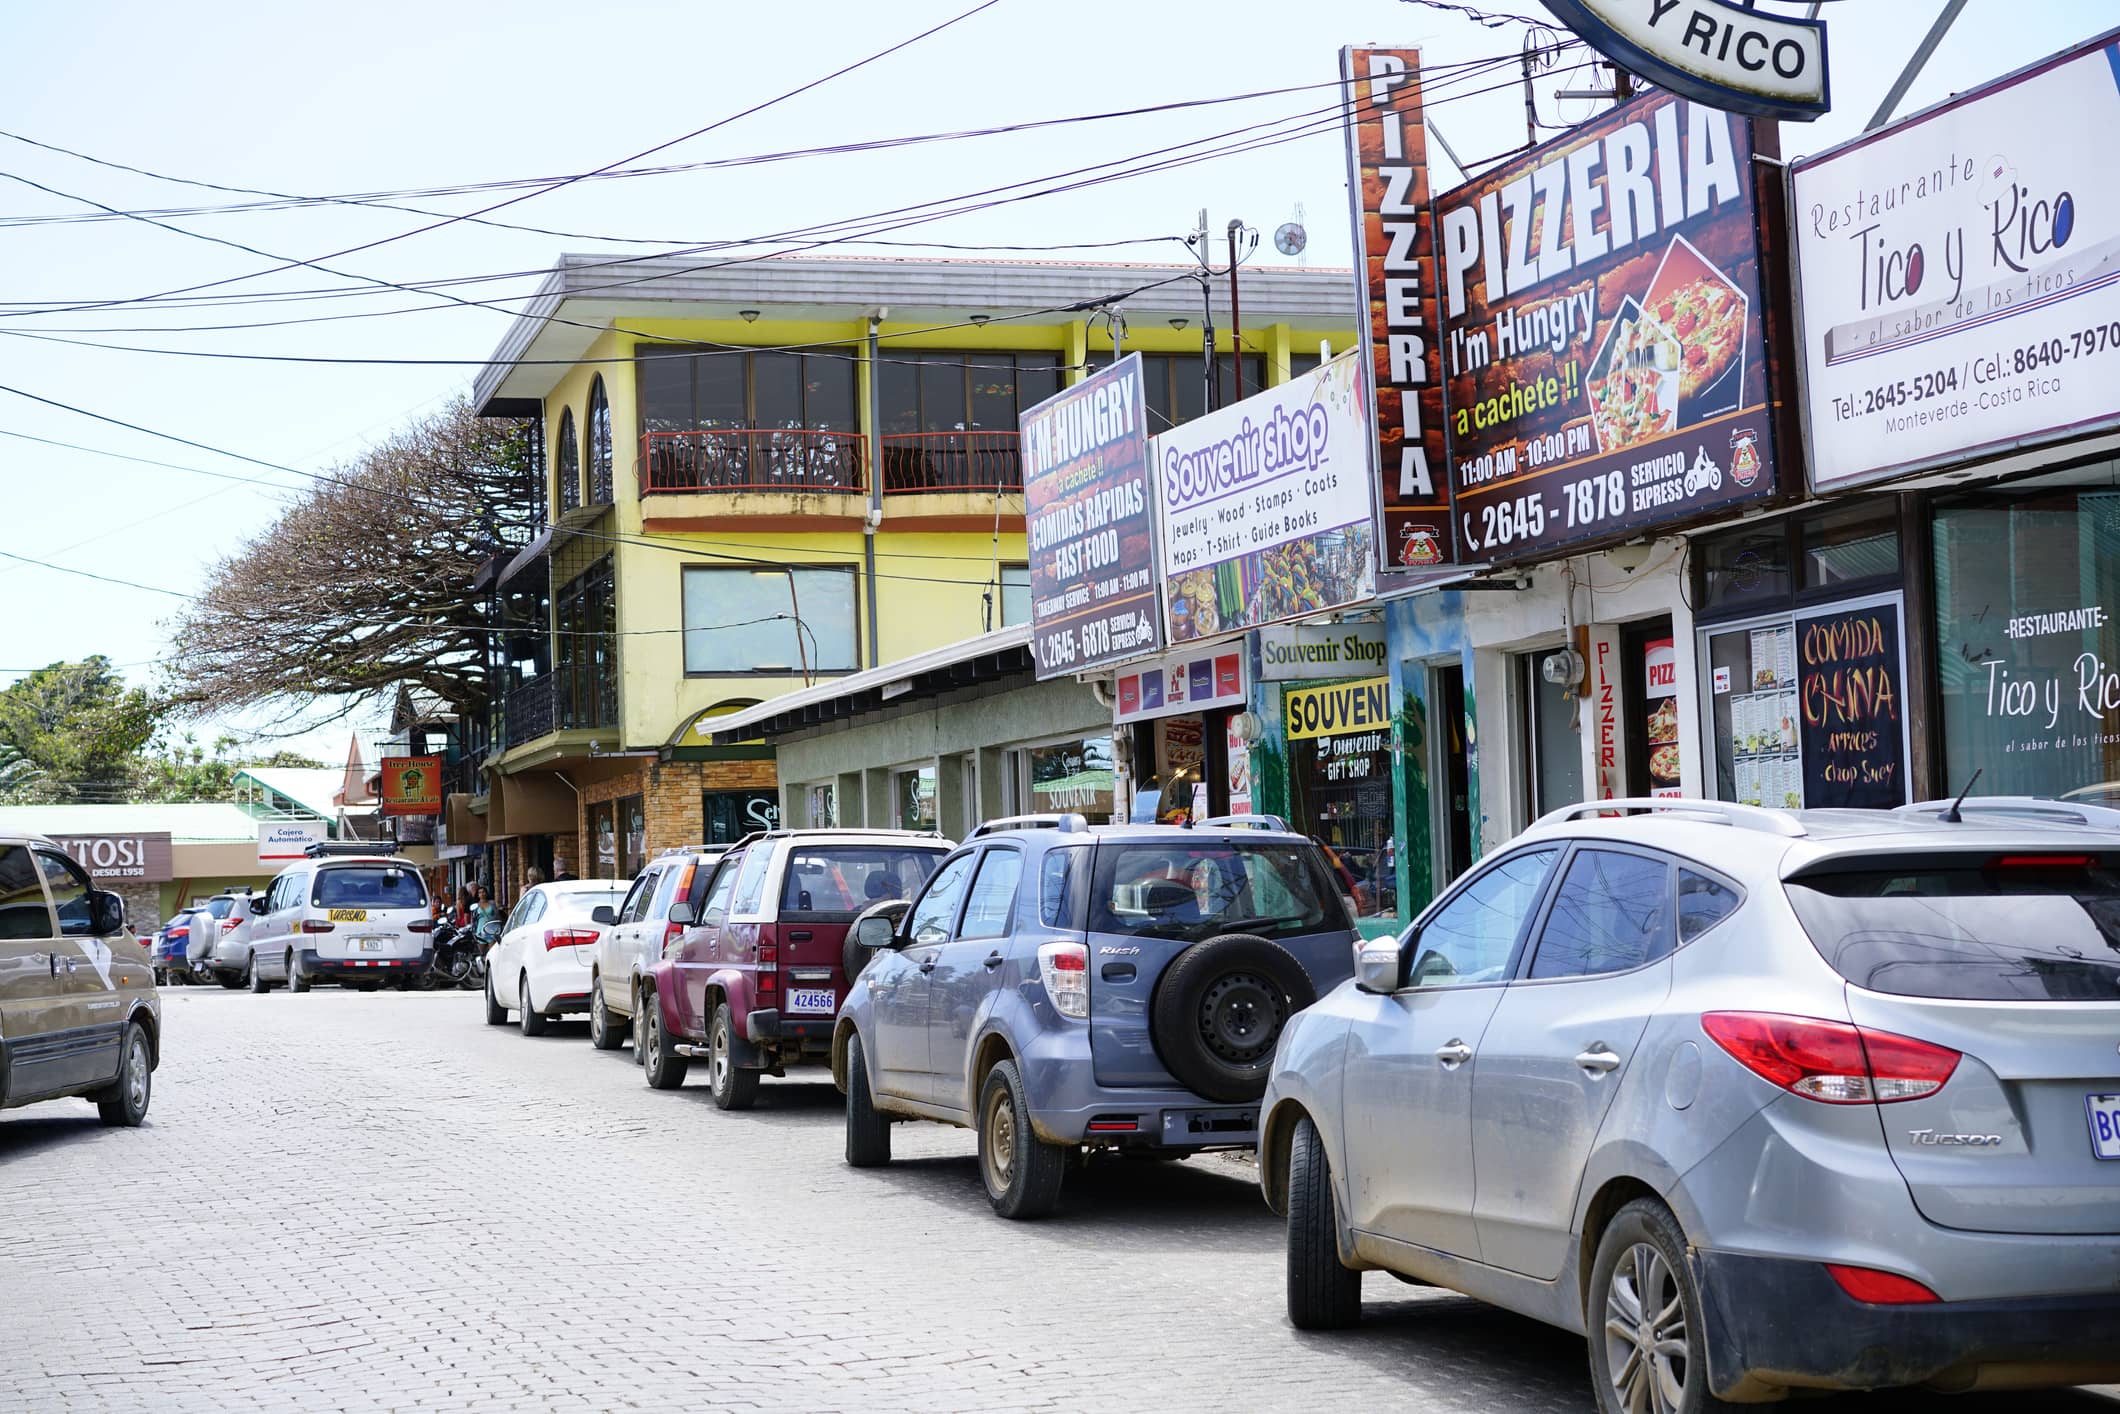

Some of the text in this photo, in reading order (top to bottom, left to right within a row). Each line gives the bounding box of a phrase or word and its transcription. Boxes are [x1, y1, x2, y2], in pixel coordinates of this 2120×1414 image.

[1648, 0, 1805, 79] Y RICO
[1443, 101, 1740, 318] PIZZERIA
[1811, 153, 1974, 239] Restaurante
[1849, 182, 2075, 311] Tico y Rico
[1367, 55, 1432, 496] PIZZERIA
[1451, 287, 1595, 377] I'm Hungry
[1869, 268, 2074, 345] el sabor de los ticos
[1026, 372, 1135, 478] I'M HUNGRY
[1457, 360, 1578, 436] a cachete !!
[1886, 398, 1968, 434] Monteverde
[2028, 376, 2061, 398] Rica
[1058, 479, 1064, 492] a
[1065, 466, 1097, 489] cachete
[1166, 402, 1328, 506] Souvenir shop
[1460, 455, 1493, 486] 11:00
[1496, 447, 1517, 477] AM
[1526, 431, 1565, 467] 10:00
[1567, 424, 1590, 455] PM
[1631, 451, 1685, 487] SERVICIO
[1032, 478, 1144, 552] COMIDAS RÁPIDAS
[1172, 472, 1337, 544] Jewelry Wood Stamps Coats
[1481, 492, 1544, 549] 2645
[1563, 470, 1625, 528] 7878
[1632, 477, 1683, 512] EXPRESS
[1055, 528, 1119, 581] FAST FOOD
[1173, 509, 1318, 566] Maps T-Shirt Guide Books
[1038, 595, 1065, 618] TAKEAWAY
[1065, 587, 1090, 608] SERVICE
[1095, 581, 1108, 599] 11:00
[1109, 578, 1120, 594] AM
[1123, 572, 1139, 591] 11:00
[1139, 568, 1149, 587] PM
[1048, 629, 1075, 668] 2645
[1081, 619, 1110, 658] 6878
[1110, 612, 1136, 633] SERVICIO
[1111, 630, 1136, 651] EXPRESS
[1265, 634, 1387, 666] Souvenir Shop
[1981, 652, 2120, 729] Tico y Ric
[1317, 731, 1381, 760] Souvenir
[1597, 642, 1615, 799] PIZZERIA
[2006, 732, 2120, 752] el sabor de los ticos
[1327, 757, 1370, 780] GIFT SHOP
[92, 868, 144, 877] DESDE 1958
[329, 909, 367, 921] TURISMO
[1100, 946, 1140, 956] Rush
[794, 994, 833, 1008] 424566
[1908, 1129, 2002, 1146] Tucson
